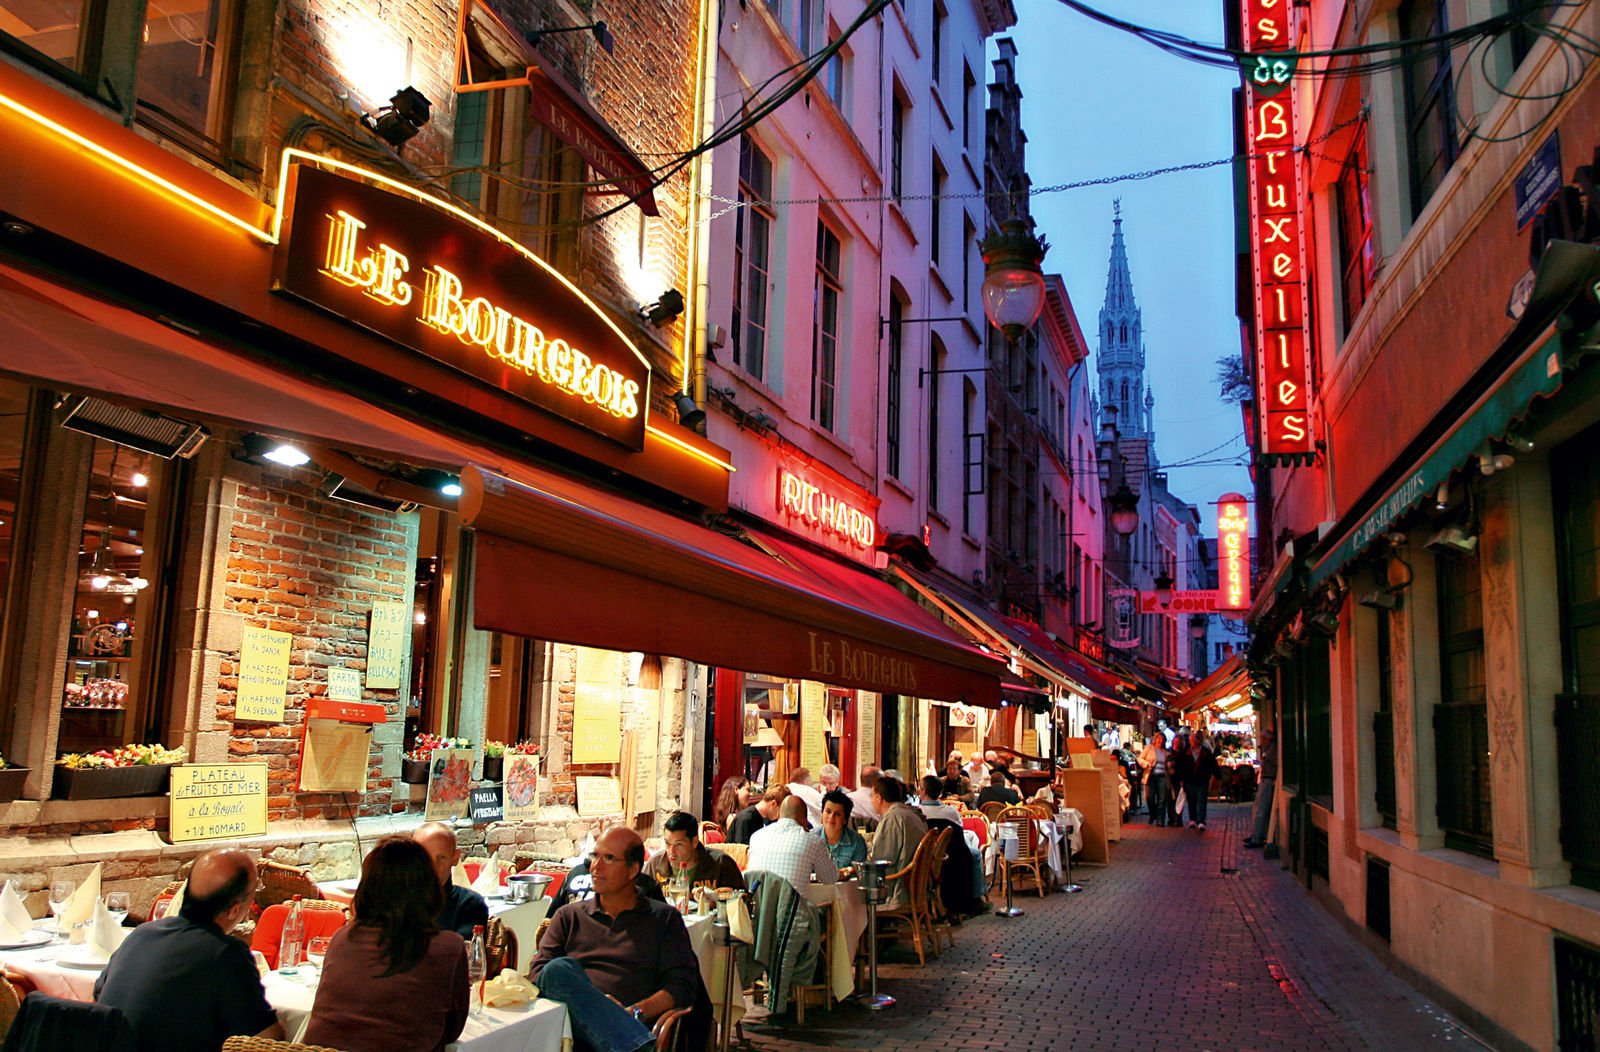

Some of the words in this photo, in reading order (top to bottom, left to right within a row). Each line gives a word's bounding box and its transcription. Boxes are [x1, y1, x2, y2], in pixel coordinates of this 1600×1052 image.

[1254, 56, 1291, 82] de
[1256, 101, 1304, 440] Bruxelles
[324, 210, 412, 305] LE
[419, 265, 639, 418] BOURGEOIS
[784, 473, 875, 547] RICHARD
[808, 631, 835, 675] LE
[331, 671, 357, 684] CARTA
[192, 769, 246, 781] PLATEAU
[222, 783, 234, 795] DE
[238, 782, 261, 793] MER
[474, 792, 498, 803] PAELLA
[199, 802, 209, 816] la
[209, 822, 246, 835] HOMARD
